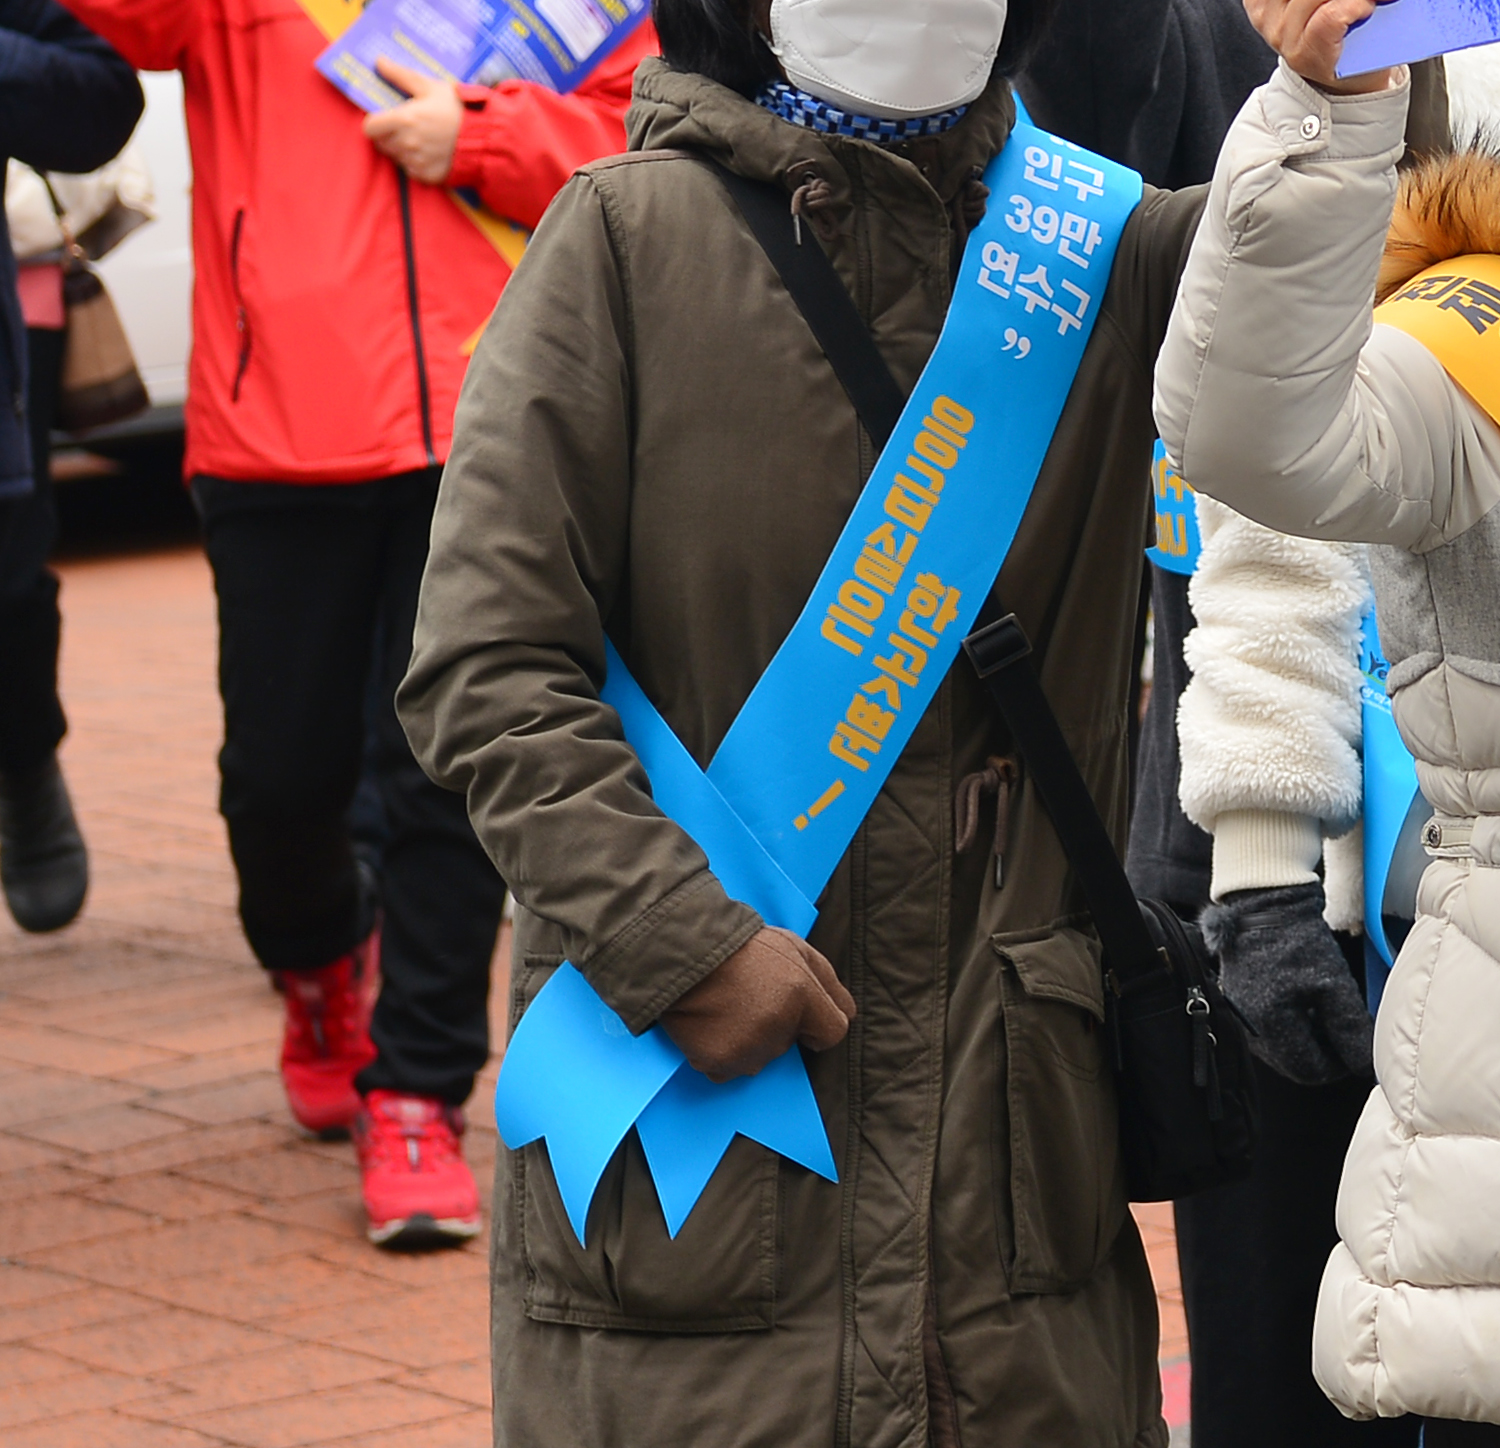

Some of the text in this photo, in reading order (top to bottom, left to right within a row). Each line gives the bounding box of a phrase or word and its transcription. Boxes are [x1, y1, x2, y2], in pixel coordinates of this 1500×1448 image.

[1023, 145, 1105, 202] 인구
[1004, 194, 1102, 269] 39만
[976, 240, 1091, 336] 연수구
[821, 393, 976, 658] 응급실은
